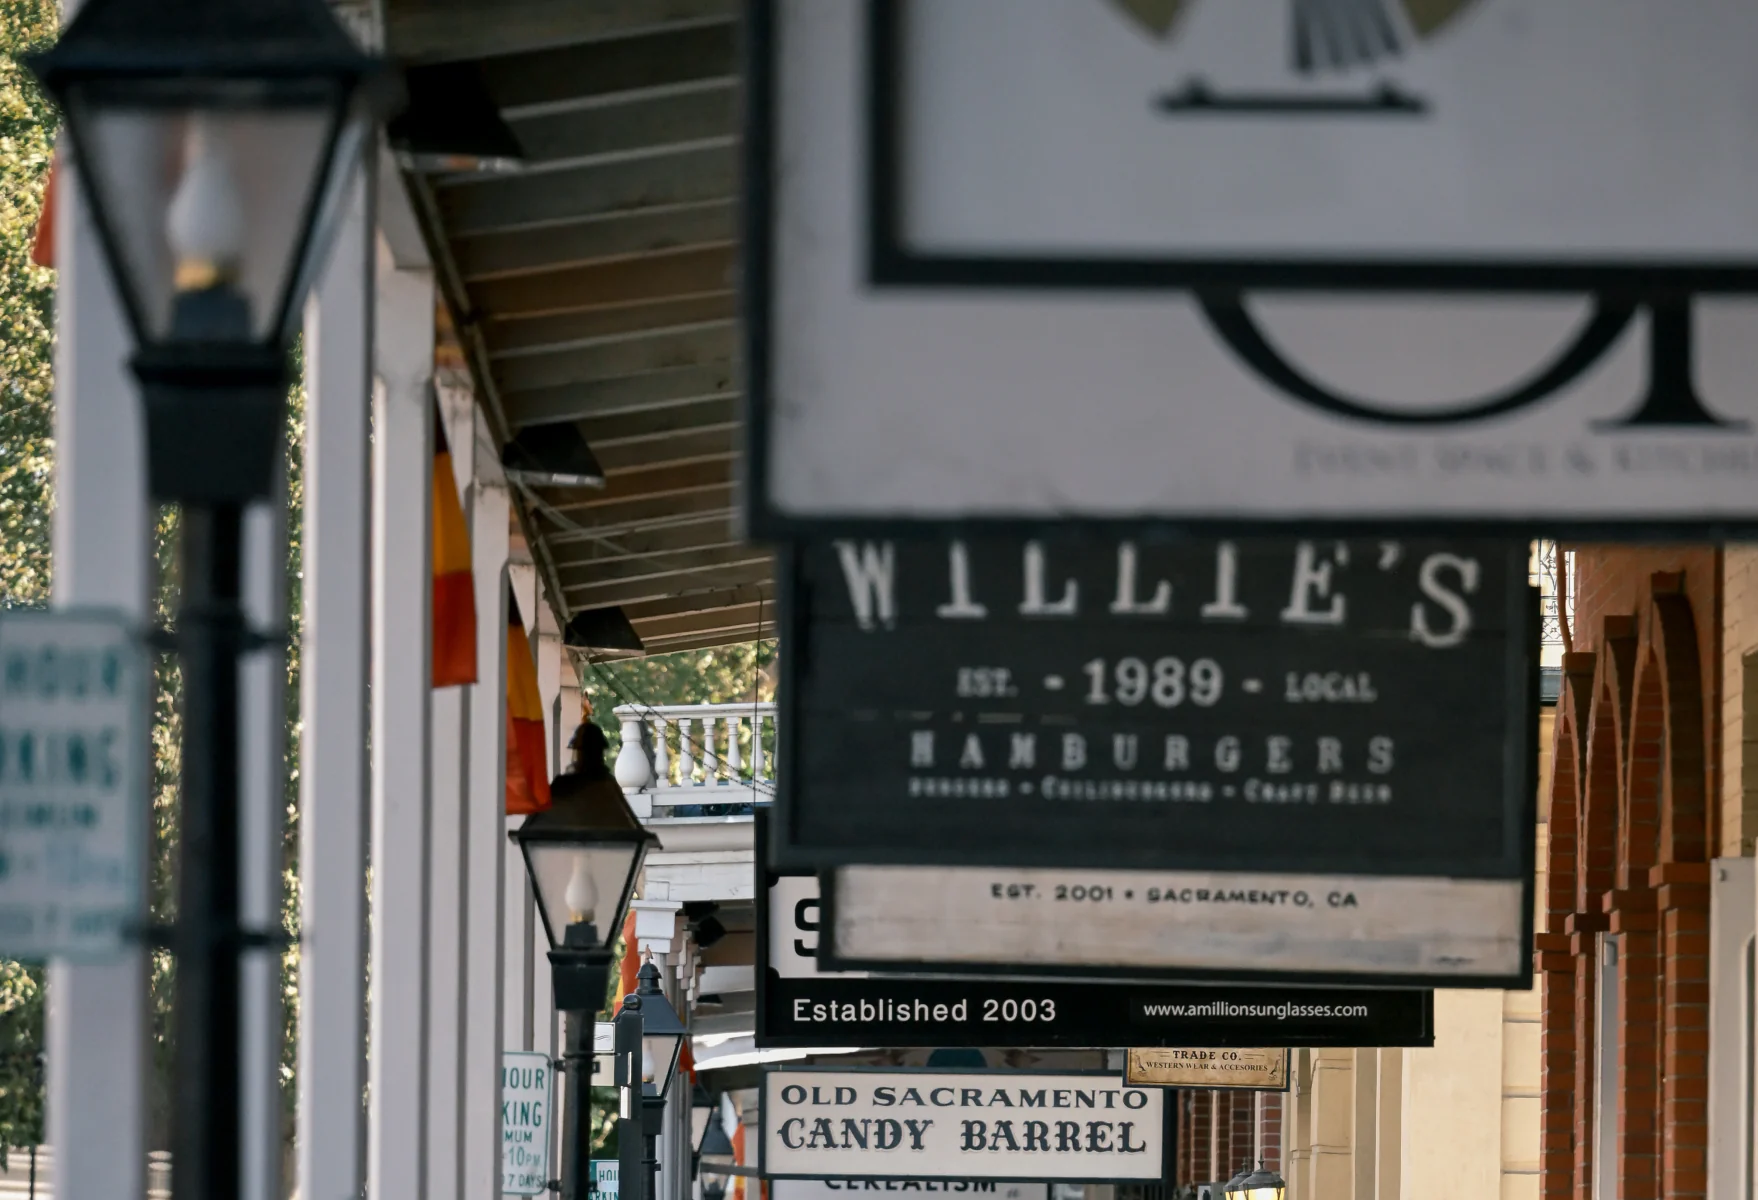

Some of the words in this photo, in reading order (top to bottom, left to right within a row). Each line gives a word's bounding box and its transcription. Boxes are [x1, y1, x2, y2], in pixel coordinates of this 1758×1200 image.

[1611, 441, 1758, 476] KITCHE
[1085, 657, 1223, 706] 1989
[1285, 672, 1378, 702] LOCAL
[911, 731, 1395, 774] HAMBURGERS
[991, 883, 1041, 900] EST.
[1055, 884, 1113, 901] 2001
[1147, 887, 1315, 908] SACRAMENTO,
[1326, 891, 1358, 907] CA
[793, 998, 967, 1022] Established
[982, 998, 1057, 1022] 2003
[1143, 1002, 1368, 1019] www.amillionsunglasses.com
[1146, 1061, 1184, 1069] WESTERN
[1186, 1062, 1209, 1070] WEAR
[1220, 1063, 1268, 1071] ACCESORIES
[1173, 1050, 1216, 1060] TRADE
[1222, 1051, 1242, 1061] CO.
[781, 1084, 858, 1105] OLD
[872, 1086, 1149, 1110] SACRAMENTO
[502, 1101, 542, 1127] KING
[505, 1130, 532, 1143] MUM
[777, 1117, 934, 1151] CANDY
[960, 1119, 1148, 1154] BARREL
[519, 1174, 543, 1188] DAYS
